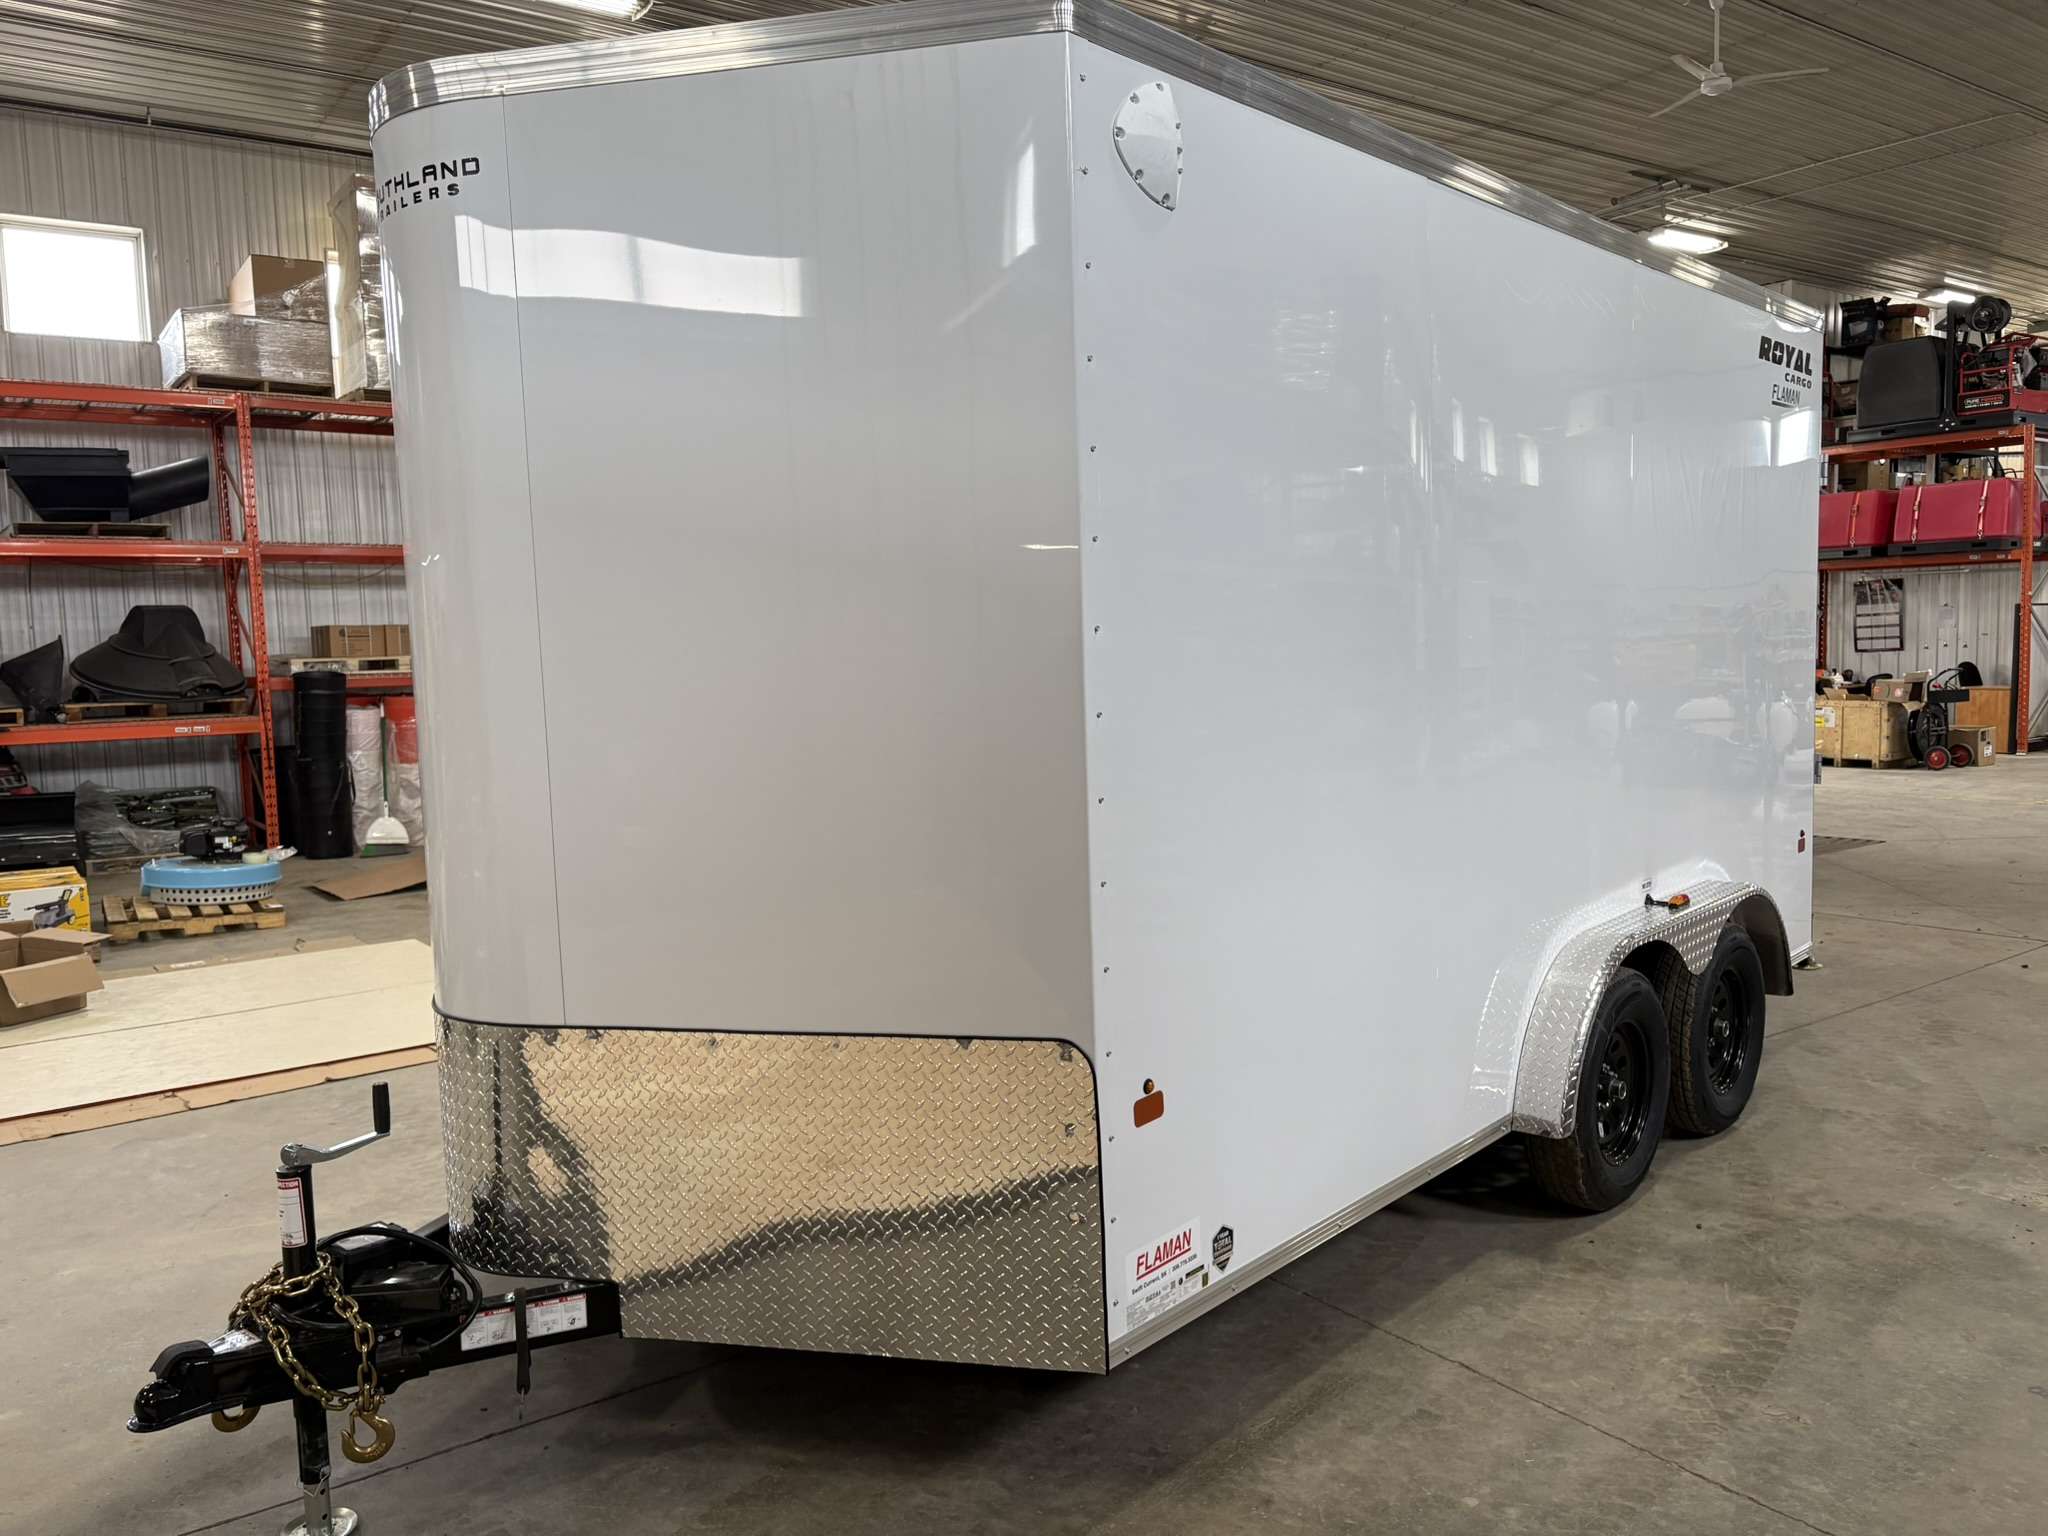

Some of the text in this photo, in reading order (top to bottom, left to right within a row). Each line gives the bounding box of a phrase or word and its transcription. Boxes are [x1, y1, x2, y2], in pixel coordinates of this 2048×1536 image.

[376, 157, 480, 203] UTHLAND
[1759, 336, 1812, 376] ROYAL
[1772, 384, 1801, 406] FLAMAN
[1784, 373, 1812, 389] CARGO
[1137, 1228, 1192, 1276] FLAMAN
